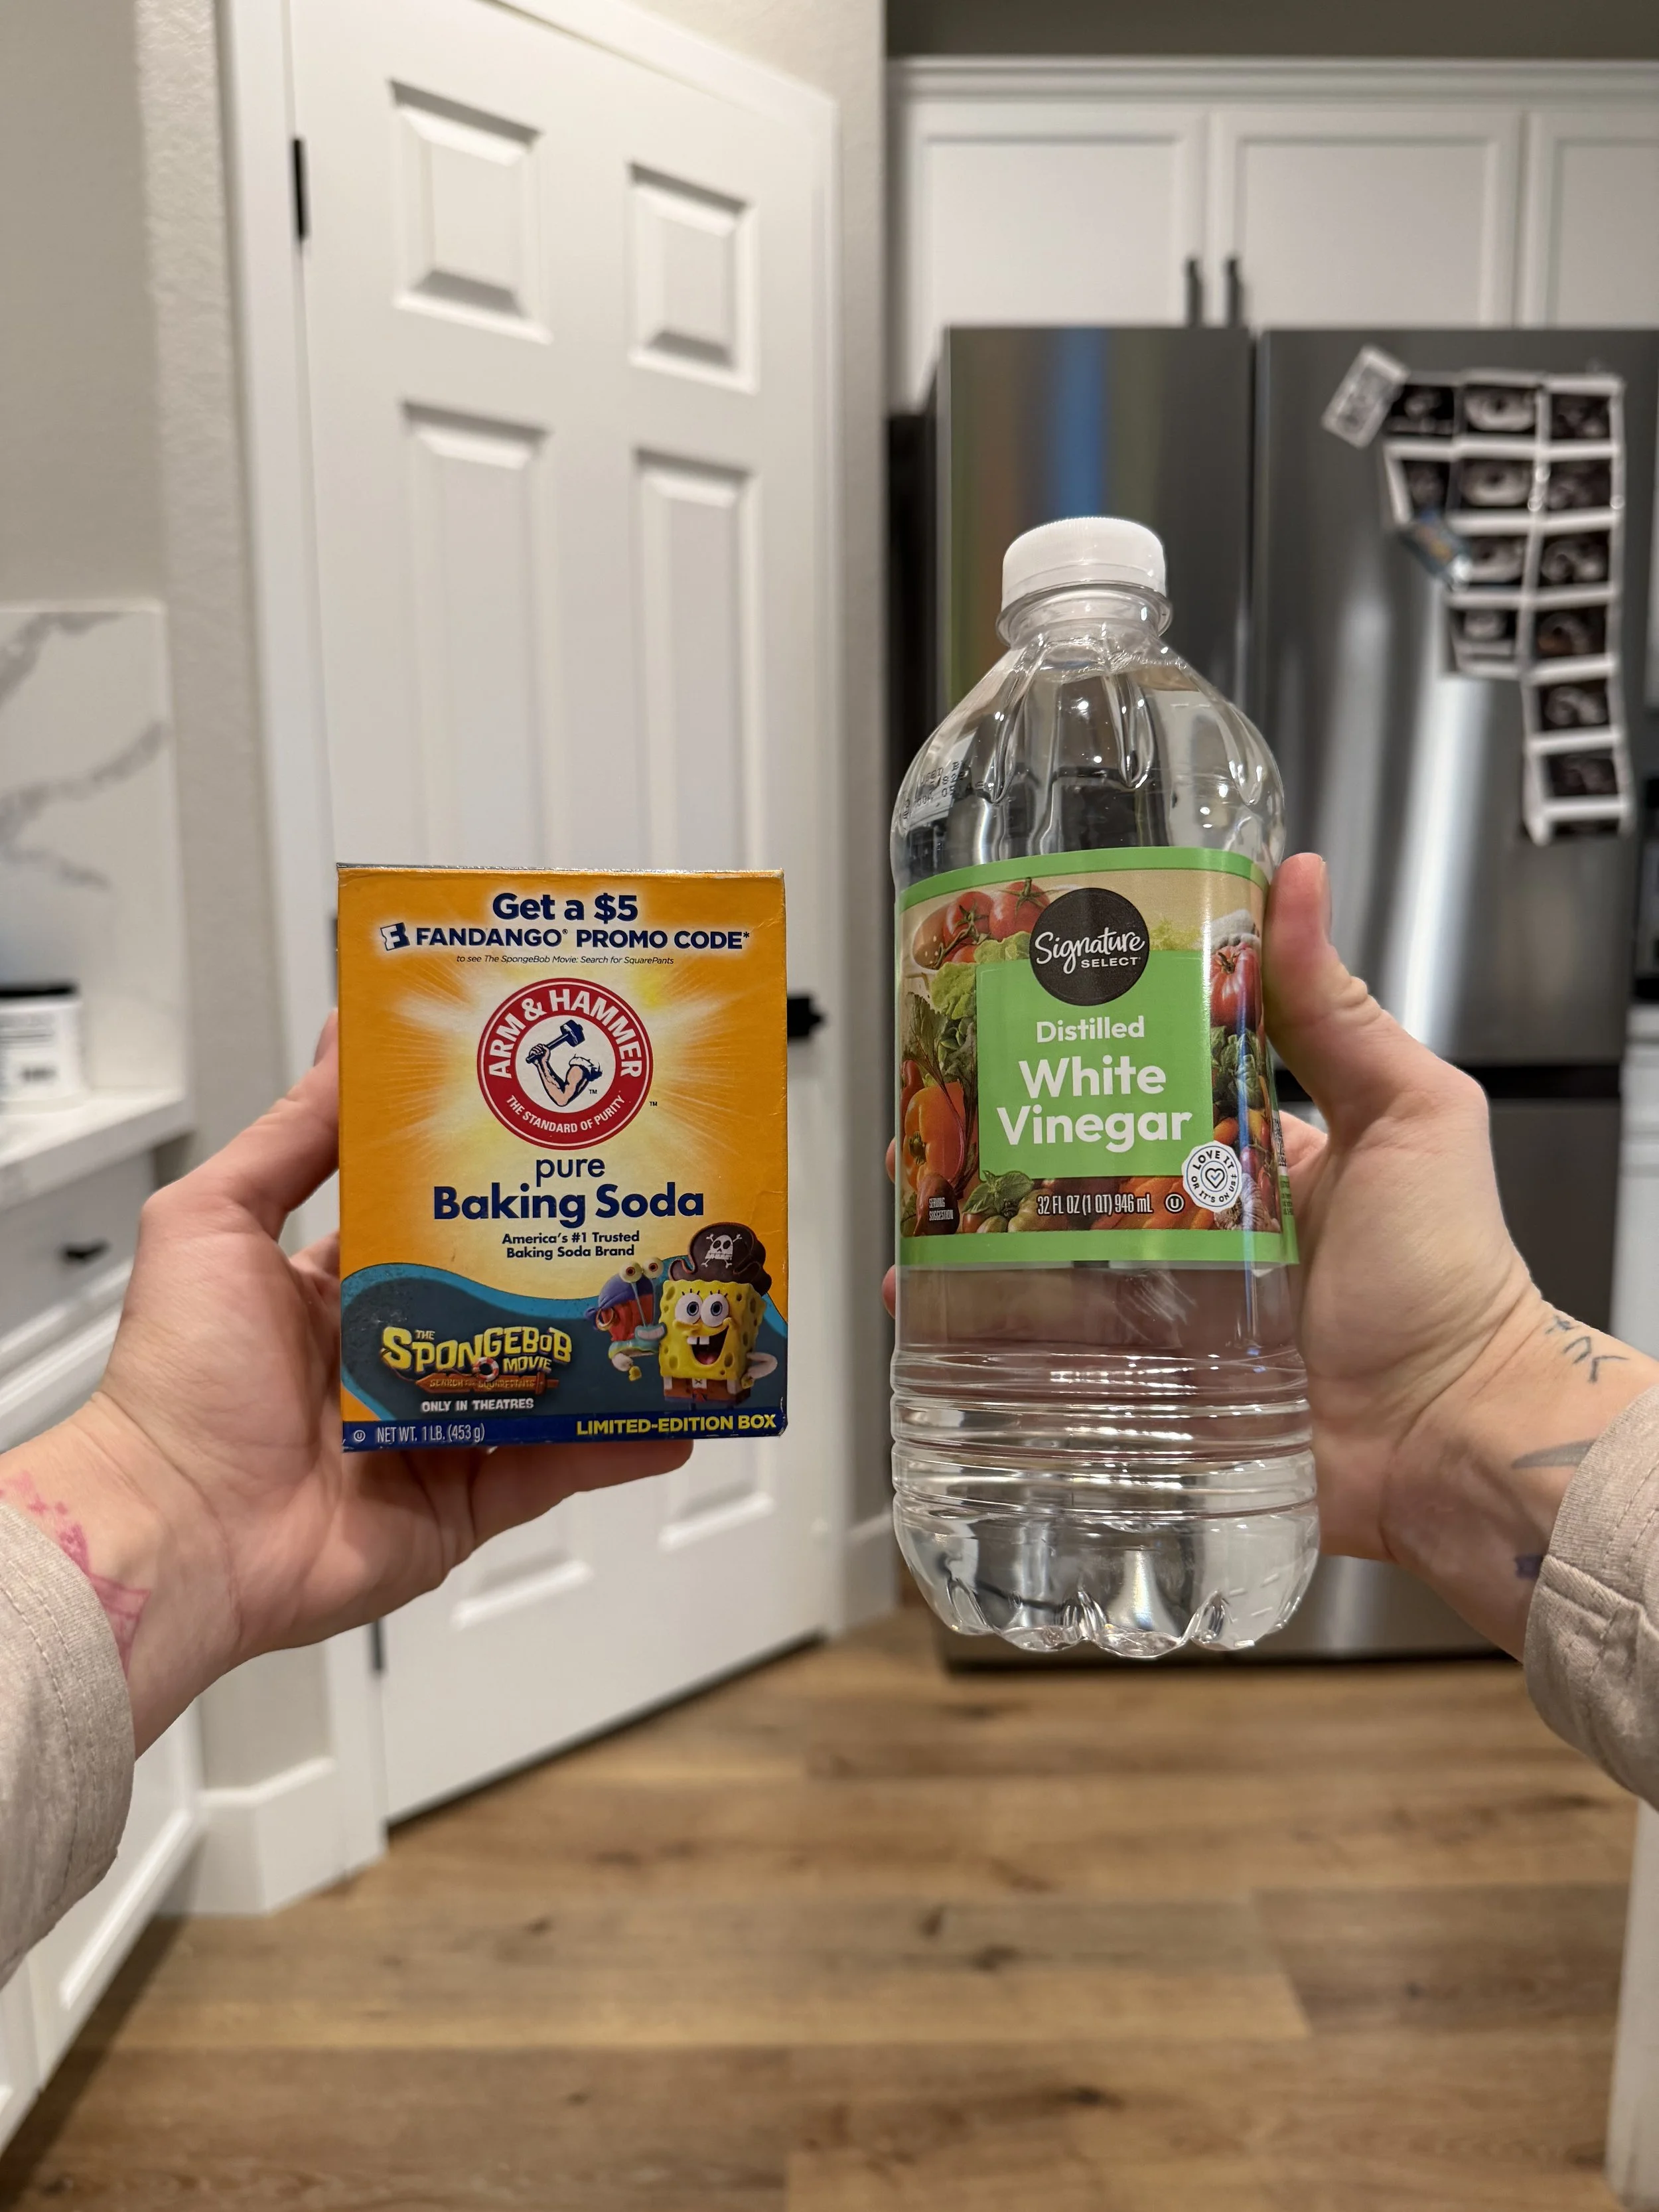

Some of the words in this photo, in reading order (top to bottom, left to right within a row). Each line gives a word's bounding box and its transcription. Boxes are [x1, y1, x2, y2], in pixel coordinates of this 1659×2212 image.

[493, 893, 555, 920] Get
[564, 900, 584, 921] a
[594, 893, 638, 924] $5
[577, 930, 668, 948] PROMO
[1035, 927, 1145, 974] Signature
[501, 955, 550, 964] SpongeBob
[624, 956, 674, 965] SquarePants
[488, 1013, 526, 1078] ARM
[522, 998, 547, 1021] &
[549, 989, 642, 1078] HAMMER
[1037, 1015, 1145, 1043] Distilled
[1019, 1055, 1166, 1098] White
[506, 1095, 521, 1115] THE
[523, 1112, 578, 1133] STANDARD
[581, 1119, 593, 1131] OF
[596, 1095, 625, 1126] PURITY
[997, 1104, 1192, 1153] Vinegar
[1192, 1150, 1221, 1170] LOVE
[1223, 1156, 1234, 1169] IT
[536, 1158, 605, 1187] pure
[1191, 1176, 1200, 1189] OR
[1198, 1191, 1216, 1203] IT'S
[1219, 1193, 1230, 1203] ON
[434, 1183, 585, 1228] Baking
[595, 1182, 704, 1218] Soda
[1037, 1196, 1050, 1214] 32
[1052, 1196, 1064, 1214] FL
[1066, 1195, 1080, 1213] OZ
[1082, 1195, 1091, 1215] (1
[1096, 1194, 1112, 1215] QT)
[1115, 1194, 1134, 1213] 946
[1137, 1194, 1153, 1213] mL
[502, 1232, 568, 1244] America's
[571, 1232, 587, 1243] #1
[592, 1231, 640, 1242] Trusted
[507, 1246, 553, 1260] Baking
[557, 1246, 591, 1258] Soda
[595, 1245, 634, 1256] Brand
[415, 1329, 435, 1339] THE
[381, 1327, 572, 1372] SPONGEBOB
[504, 1357, 552, 1374] MOVIE
[421, 1401, 451, 1412] ONLY
[456, 1400, 468, 1411] IN
[472, 1398, 534, 1411] THEATRES
[377, 1427, 397, 1443] NET
[399, 1427, 418, 1441] WT.
[423, 1426, 427, 1441] 1
[431, 1426, 445, 1441] LB.
[449, 1424, 471, 1442] (453
[474, 1423, 485, 1443] g)
[577, 1416, 733, 1436] LIMITED-EDITION
[737, 1414, 776, 1430] BOX
